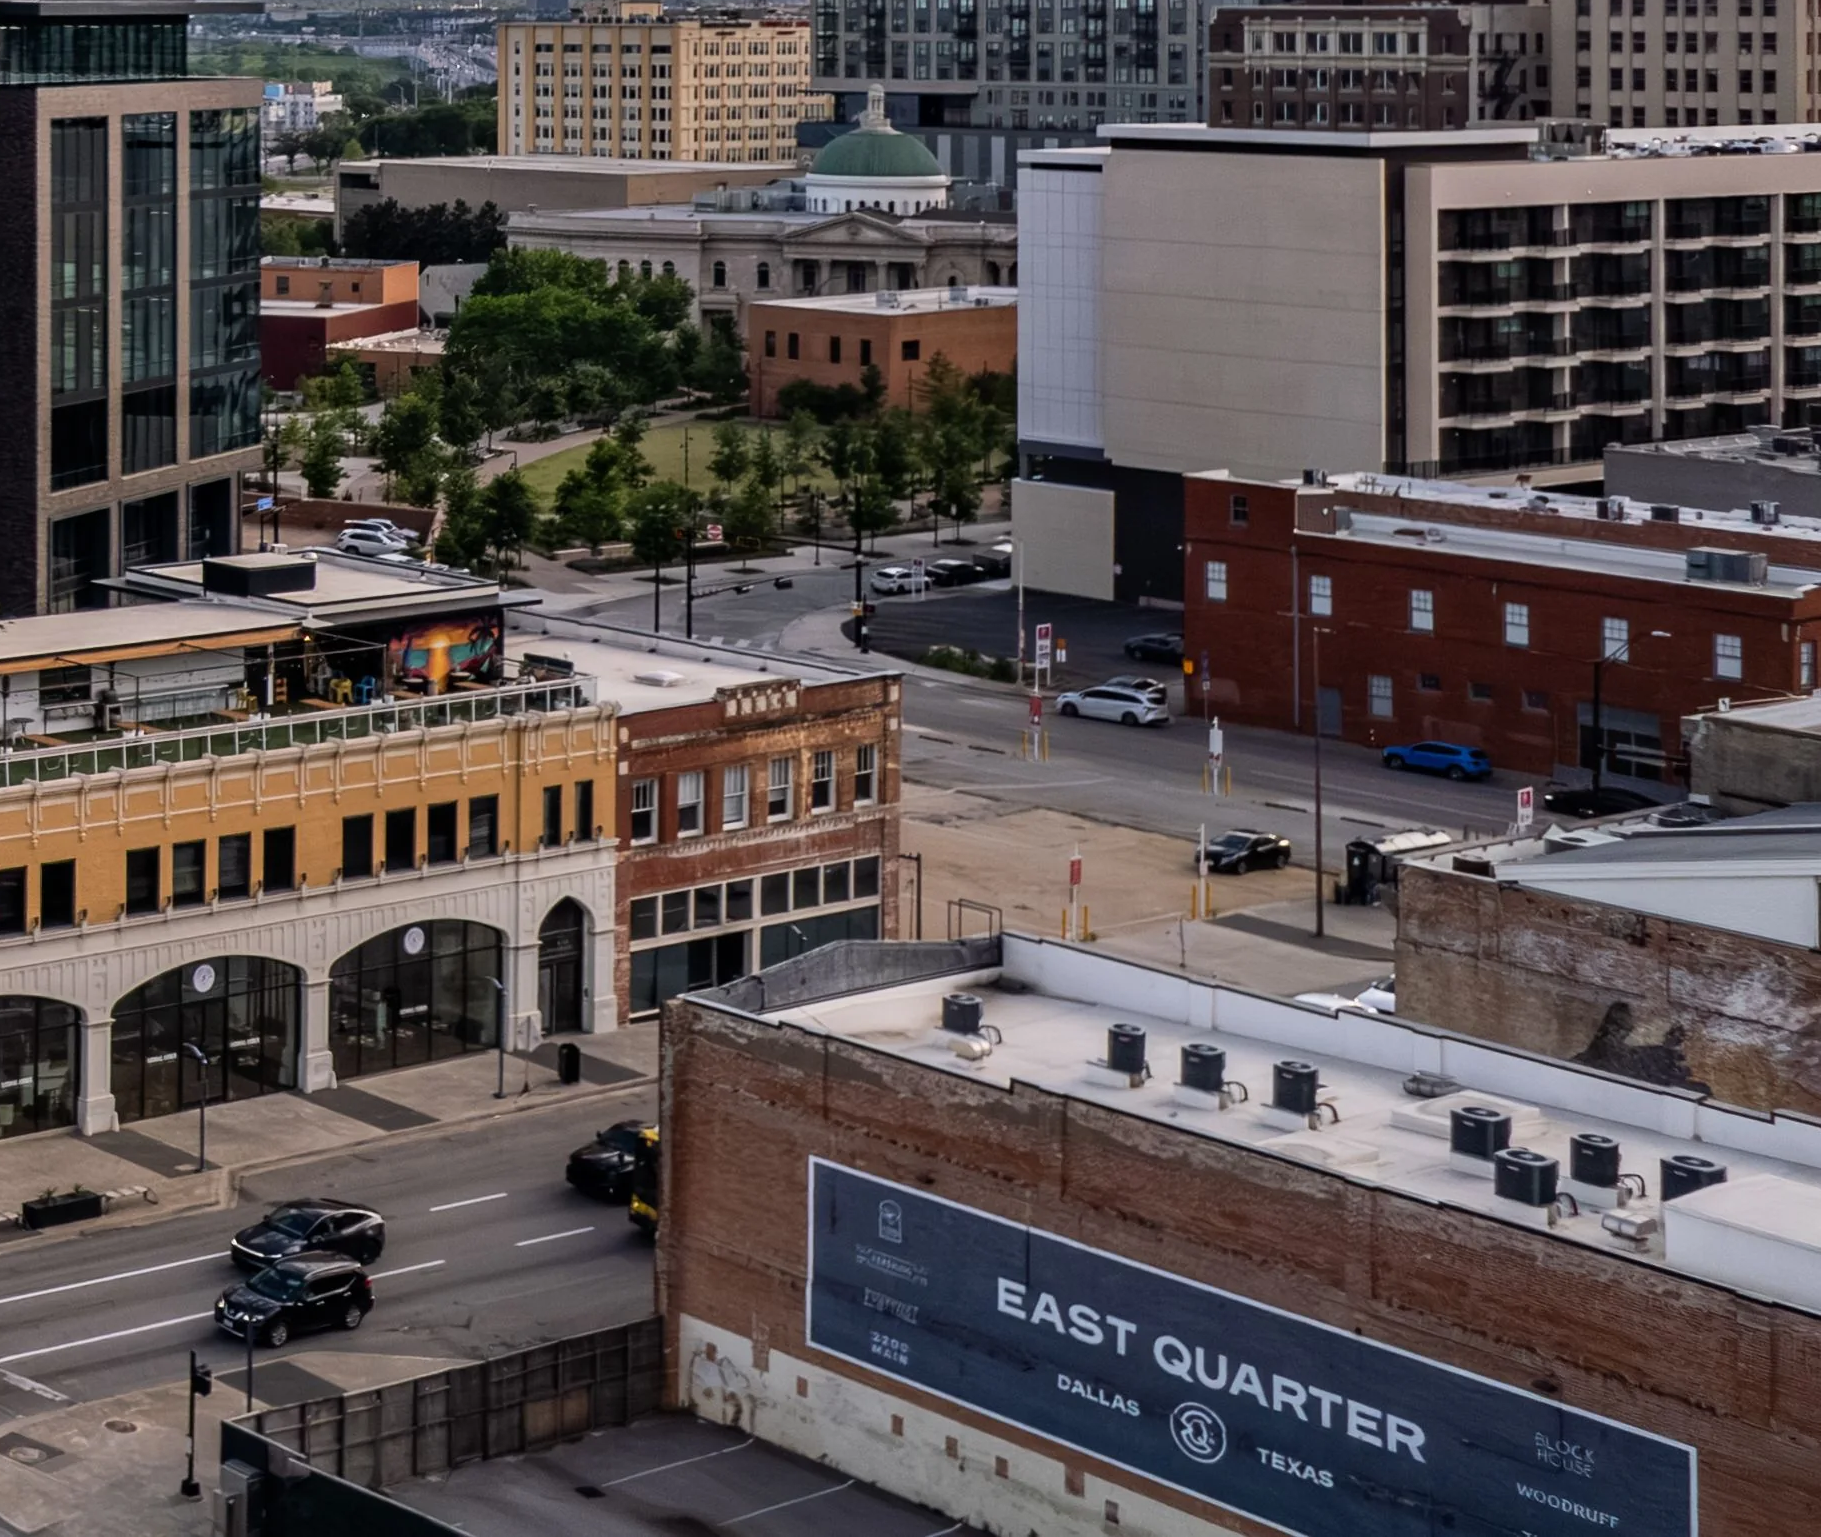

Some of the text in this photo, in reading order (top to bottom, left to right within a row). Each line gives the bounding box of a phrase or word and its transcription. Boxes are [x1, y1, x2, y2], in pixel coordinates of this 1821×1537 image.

[869, 1330, 910, 1354] 2200
[871, 1344, 909, 1366] MAIN
[997, 1276, 1427, 1464] EAST QUARTER
[1057, 1373, 1141, 1417] DALLAS
[1534, 1431, 1595, 1465] BLOCK
[1536, 1448, 1594, 1479] HOUSE
[1255, 1447, 1334, 1489] TEXAS
[1516, 1481, 1620, 1529] WOODRUFF
